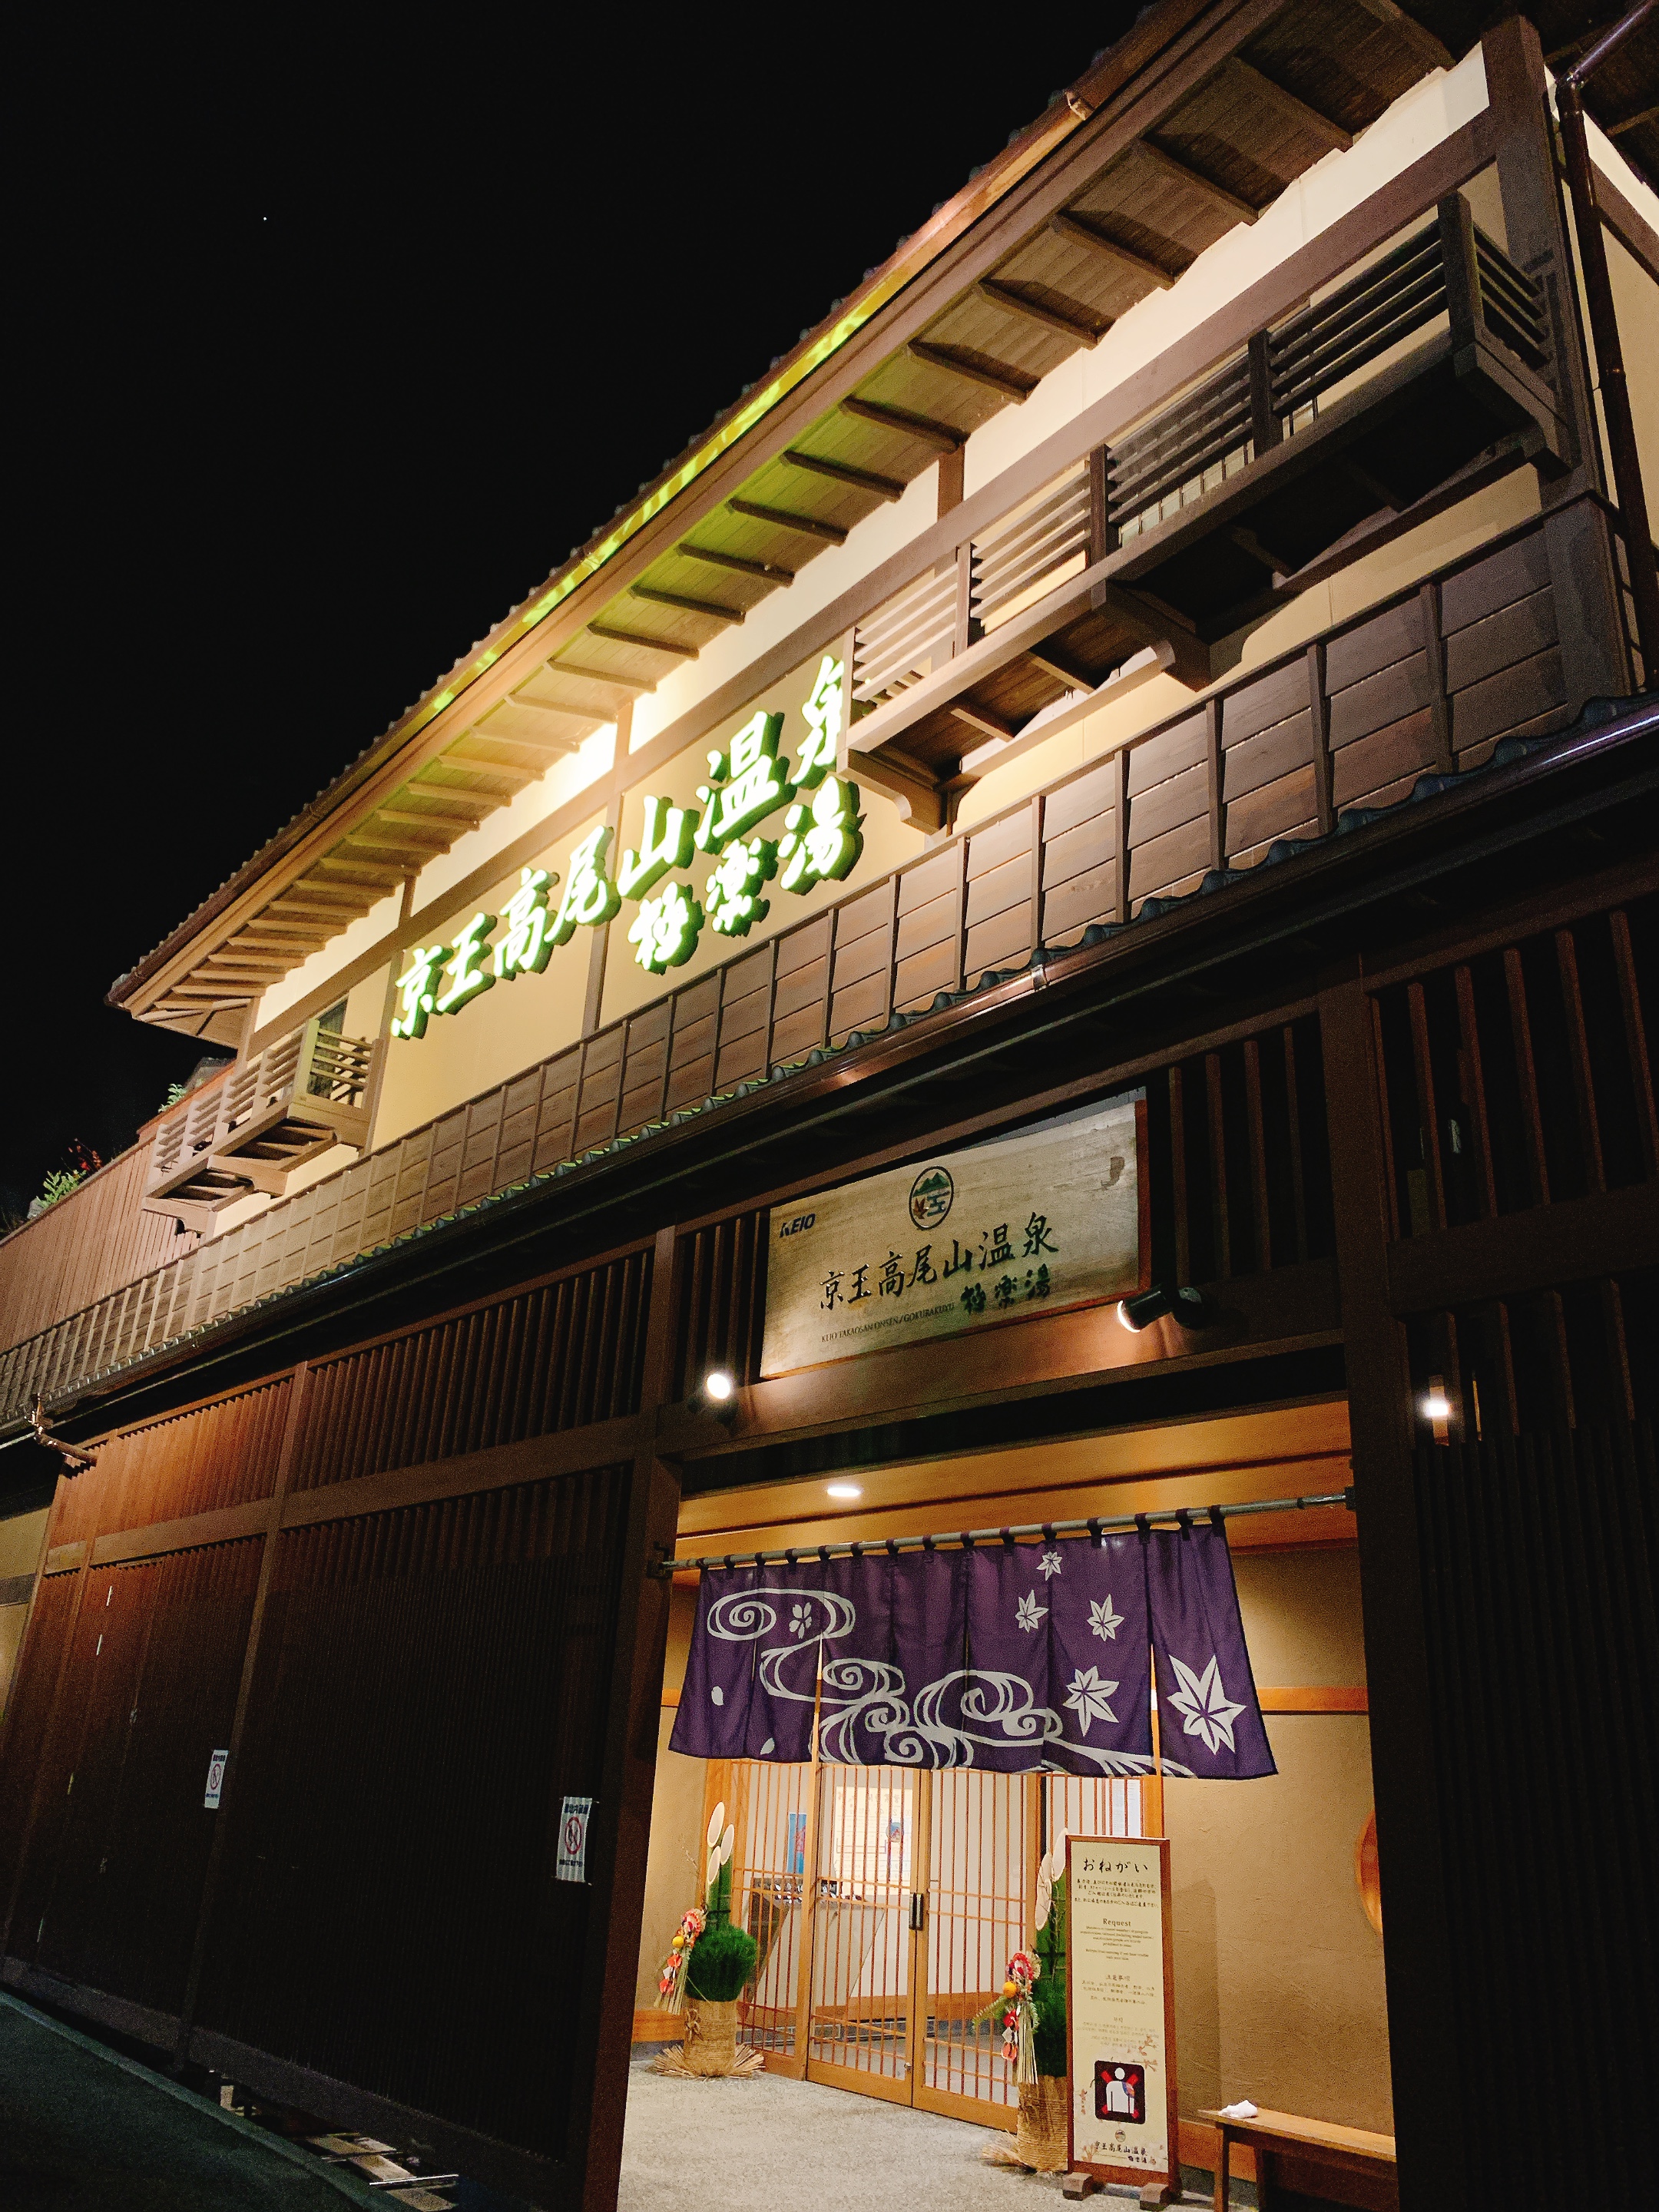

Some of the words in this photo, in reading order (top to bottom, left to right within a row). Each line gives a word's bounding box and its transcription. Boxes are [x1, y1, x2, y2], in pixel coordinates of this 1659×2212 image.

[779, 1213, 816, 1238] KEIO
[819, 1211, 1059, 1311] 京王高尾山温泉
[960, 1263, 1051, 1318] 極楽湯
[1082, 1856, 1149, 1874] おねがい
[1103, 1918, 1131, 1928] Request
